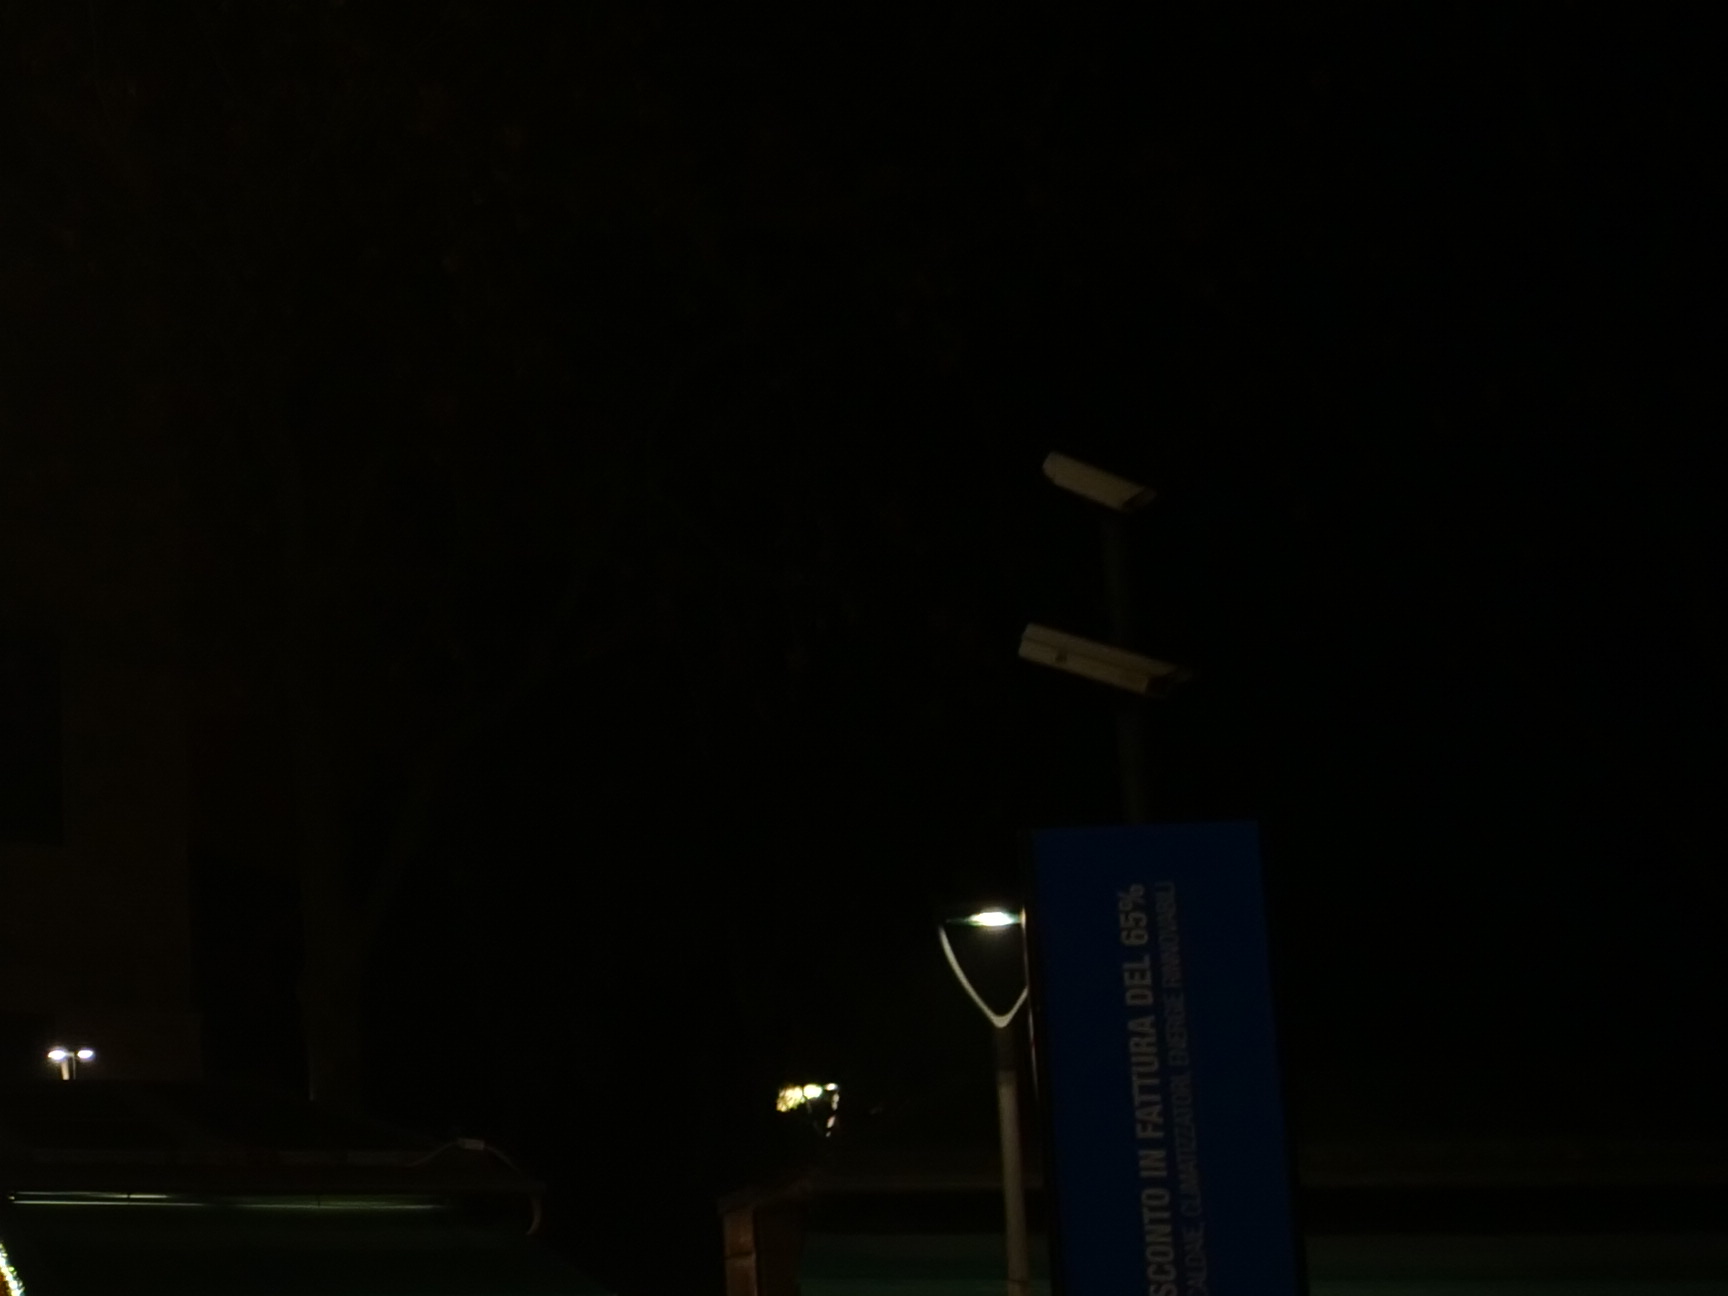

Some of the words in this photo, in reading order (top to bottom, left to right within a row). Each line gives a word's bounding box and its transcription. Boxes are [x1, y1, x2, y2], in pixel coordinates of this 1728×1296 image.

[1116, 882, 1149, 946] 65%
[1153, 880, 1182, 988] RINNOVABILI
[1121, 954, 1154, 1007] DEL
[1163, 987, 1190, 1067] ENERGIE
[1126, 1014, 1165, 1140] FATTURA
[1137, 1148, 1168, 1179] IN
